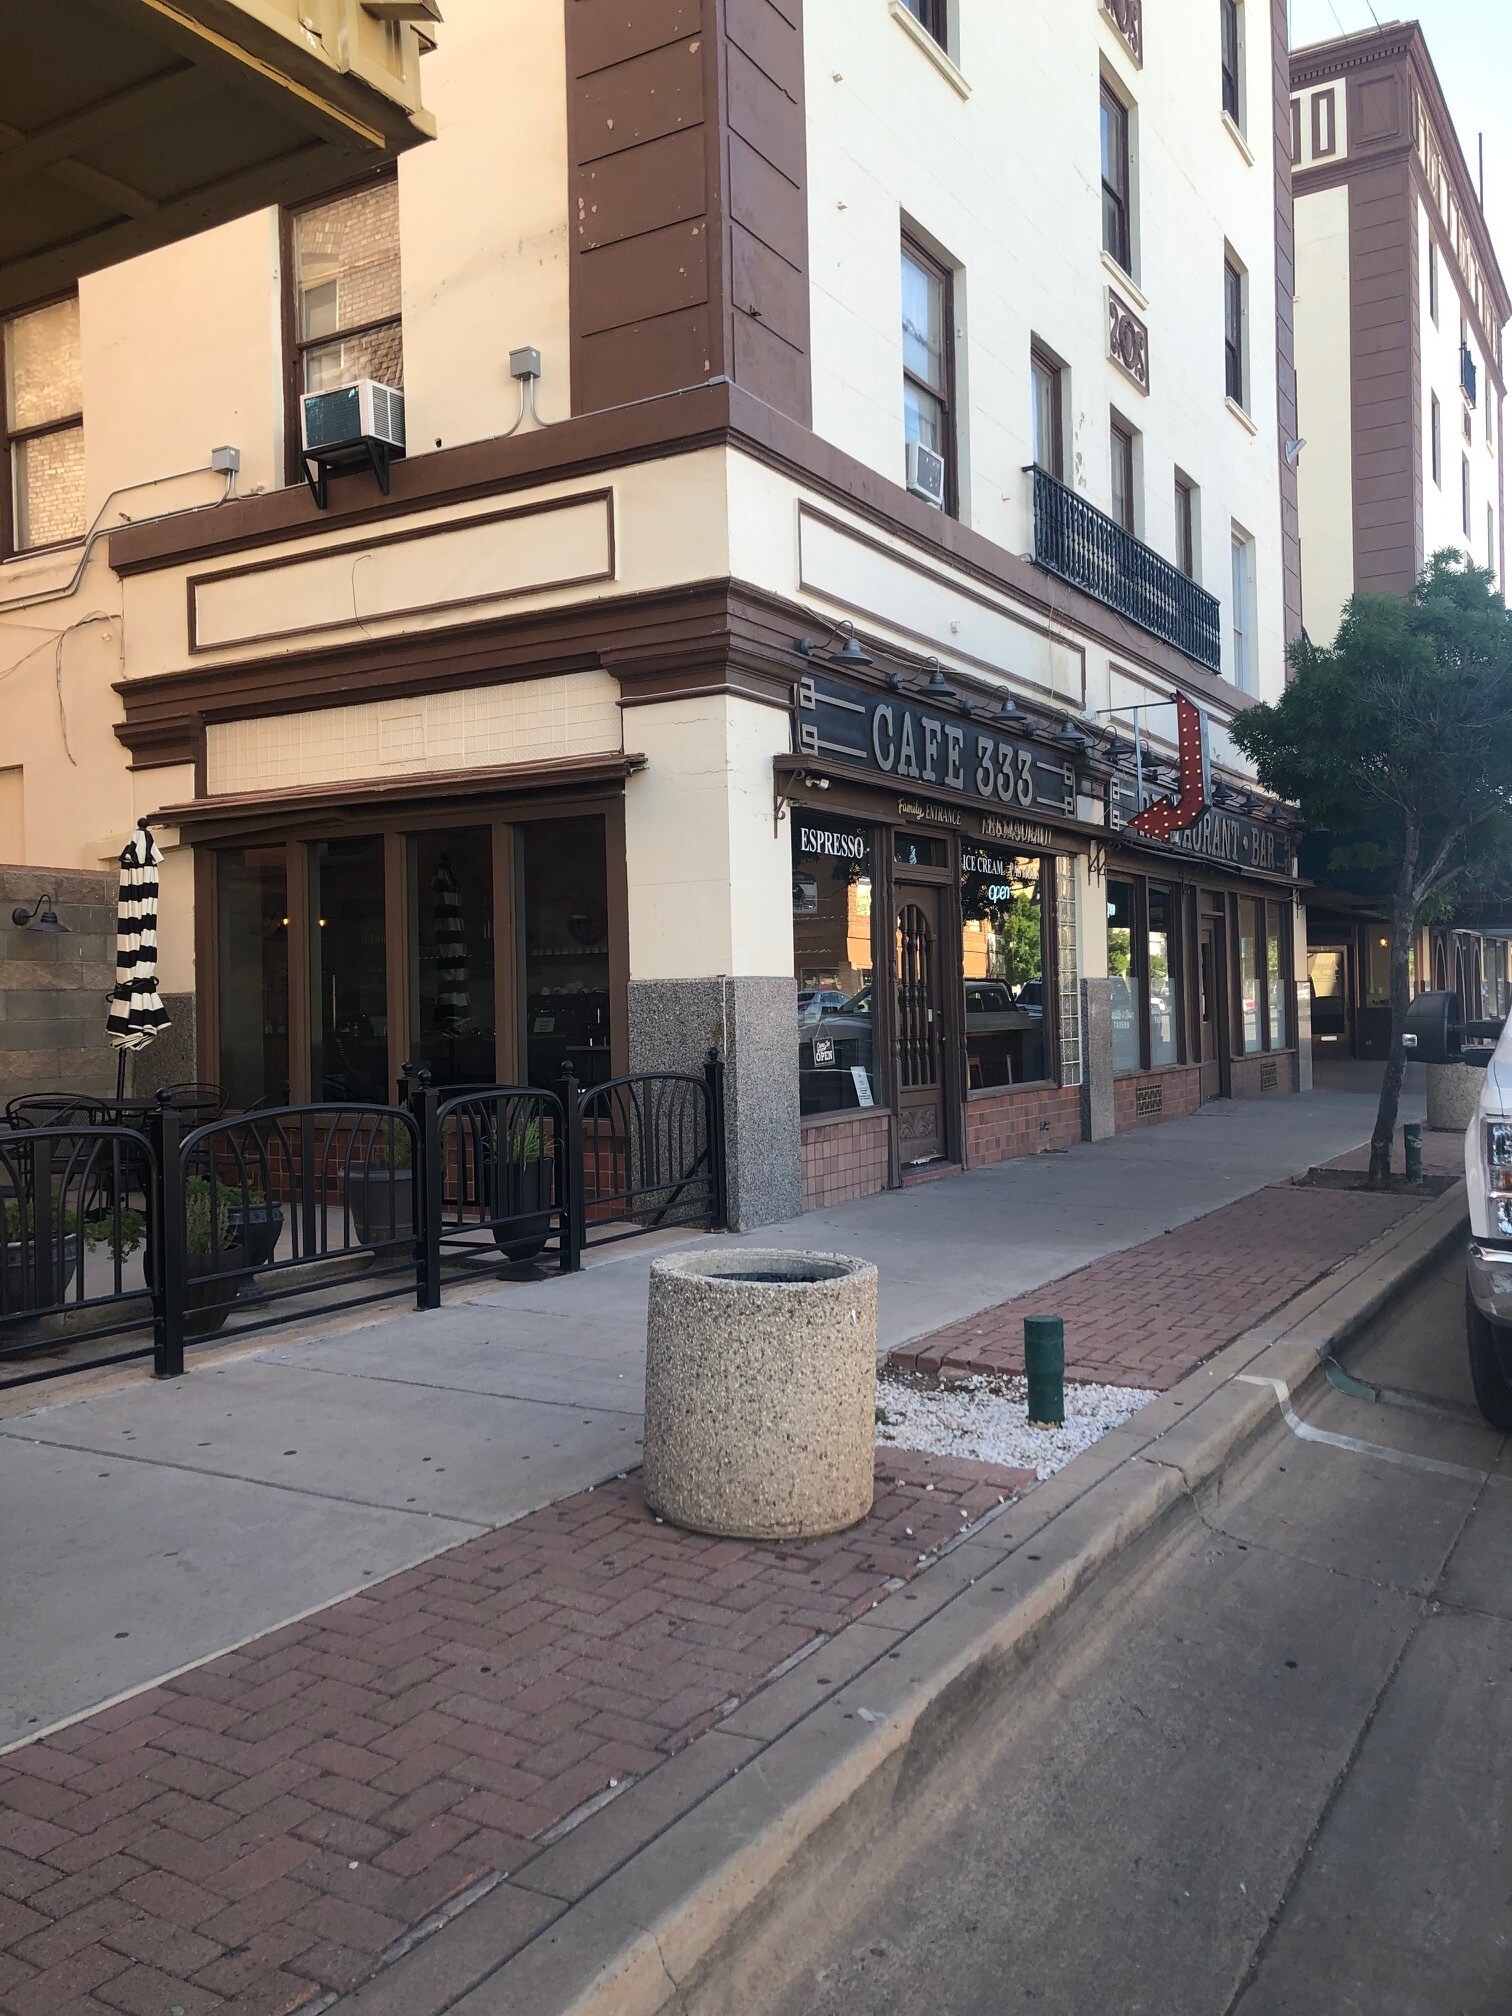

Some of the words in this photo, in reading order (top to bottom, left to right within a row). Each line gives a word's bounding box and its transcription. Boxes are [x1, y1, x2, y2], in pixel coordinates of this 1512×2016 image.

[872, 704, 965, 791] CAFE
[976, 736, 1033, 807] 333
[898, 798, 925, 820] Family
[925, 804, 962, 826] ENTRANCE
[801, 828, 864, 859] ESPRESSO
[1251, 827, 1275, 869] BAR
[962, 854, 976, 872] ICE
[977, 857, 1005, 876] CREAM
[988, 885, 1010, 903] open
[816, 1050, 833, 1062] OPEN
